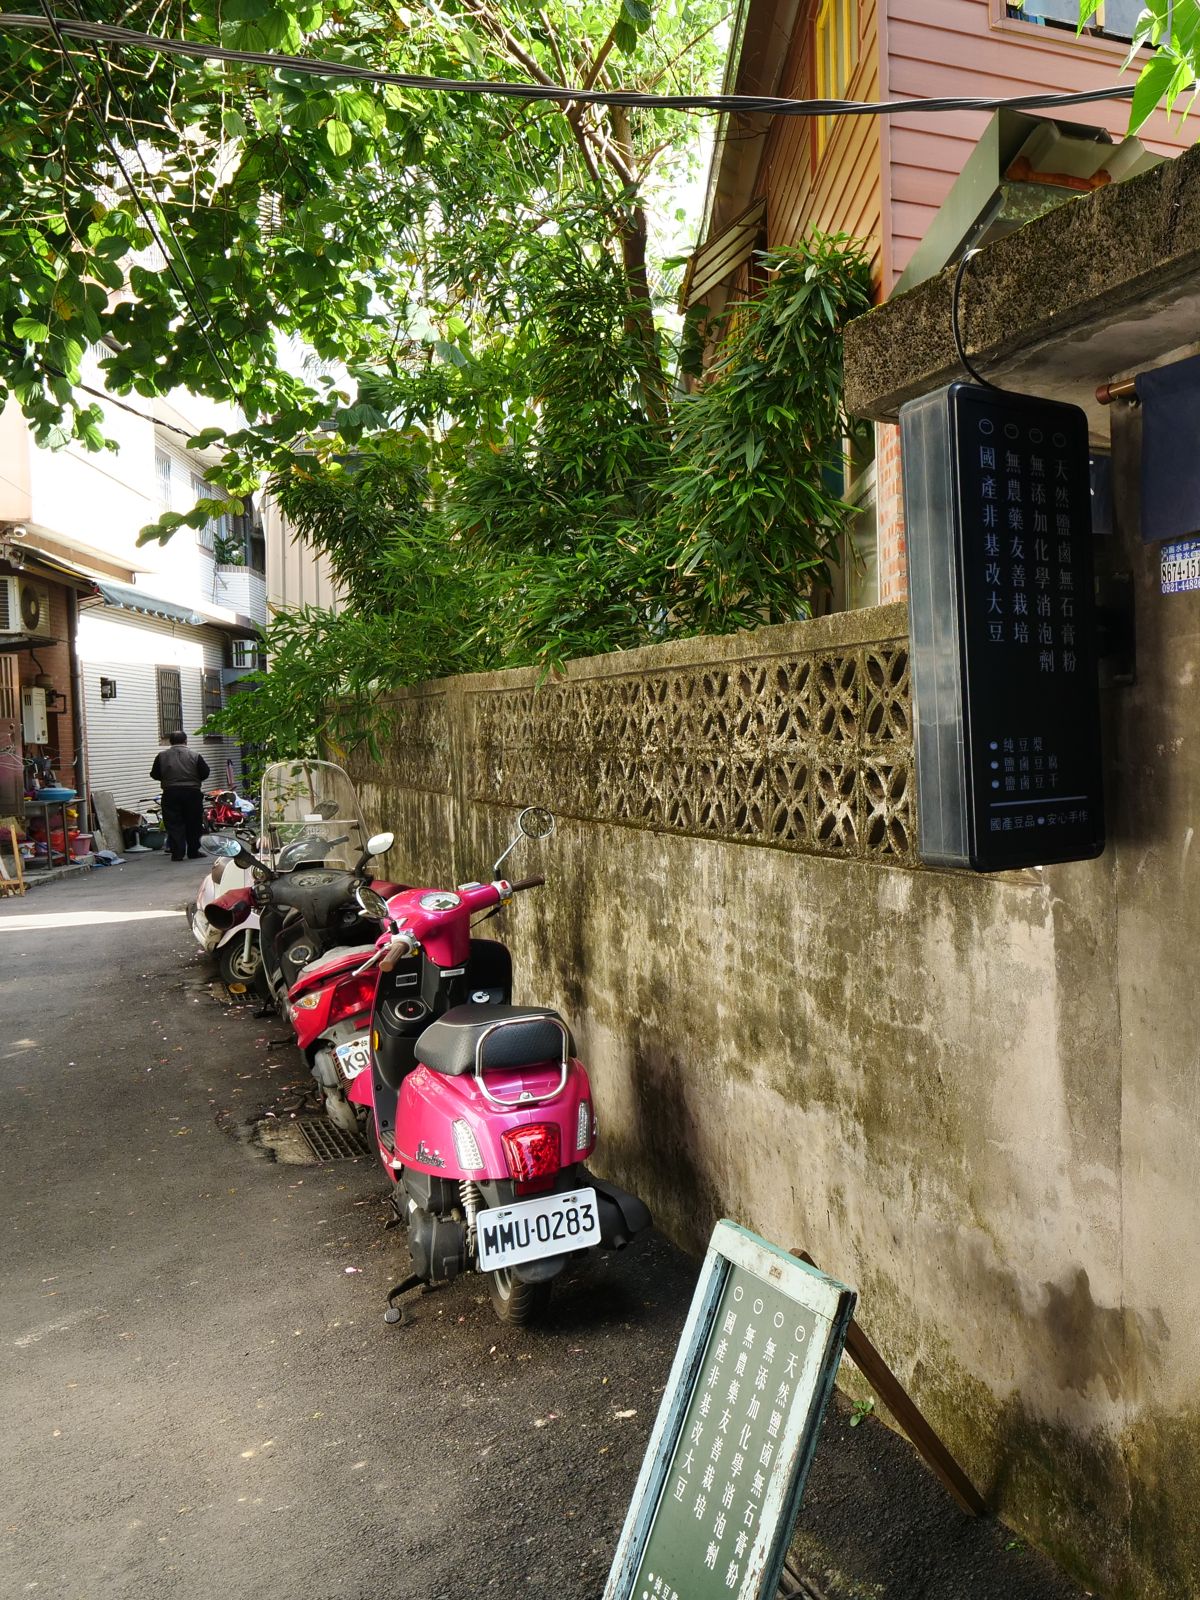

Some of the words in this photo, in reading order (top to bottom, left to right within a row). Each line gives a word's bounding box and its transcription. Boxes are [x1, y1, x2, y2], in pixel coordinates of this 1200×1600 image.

[979, 445, 1005, 642] 國產非基改大豆
[1004, 450, 1030, 643] 無農藥友善栽培
[1030, 455, 1055, 673] 無添加化學消泡劑
[1054, 459, 1077, 673] 天然鹽鹵無石膏粉
[673, 1310, 738, 1504] 國產非基改大豆
[693, 1323, 757, 1522] 無農藥友善栽培
[703, 1336, 778, 1571] 無添加化學消泡劑
[725, 1351, 799, 1589] 天然鹽鹵無石膏粉
